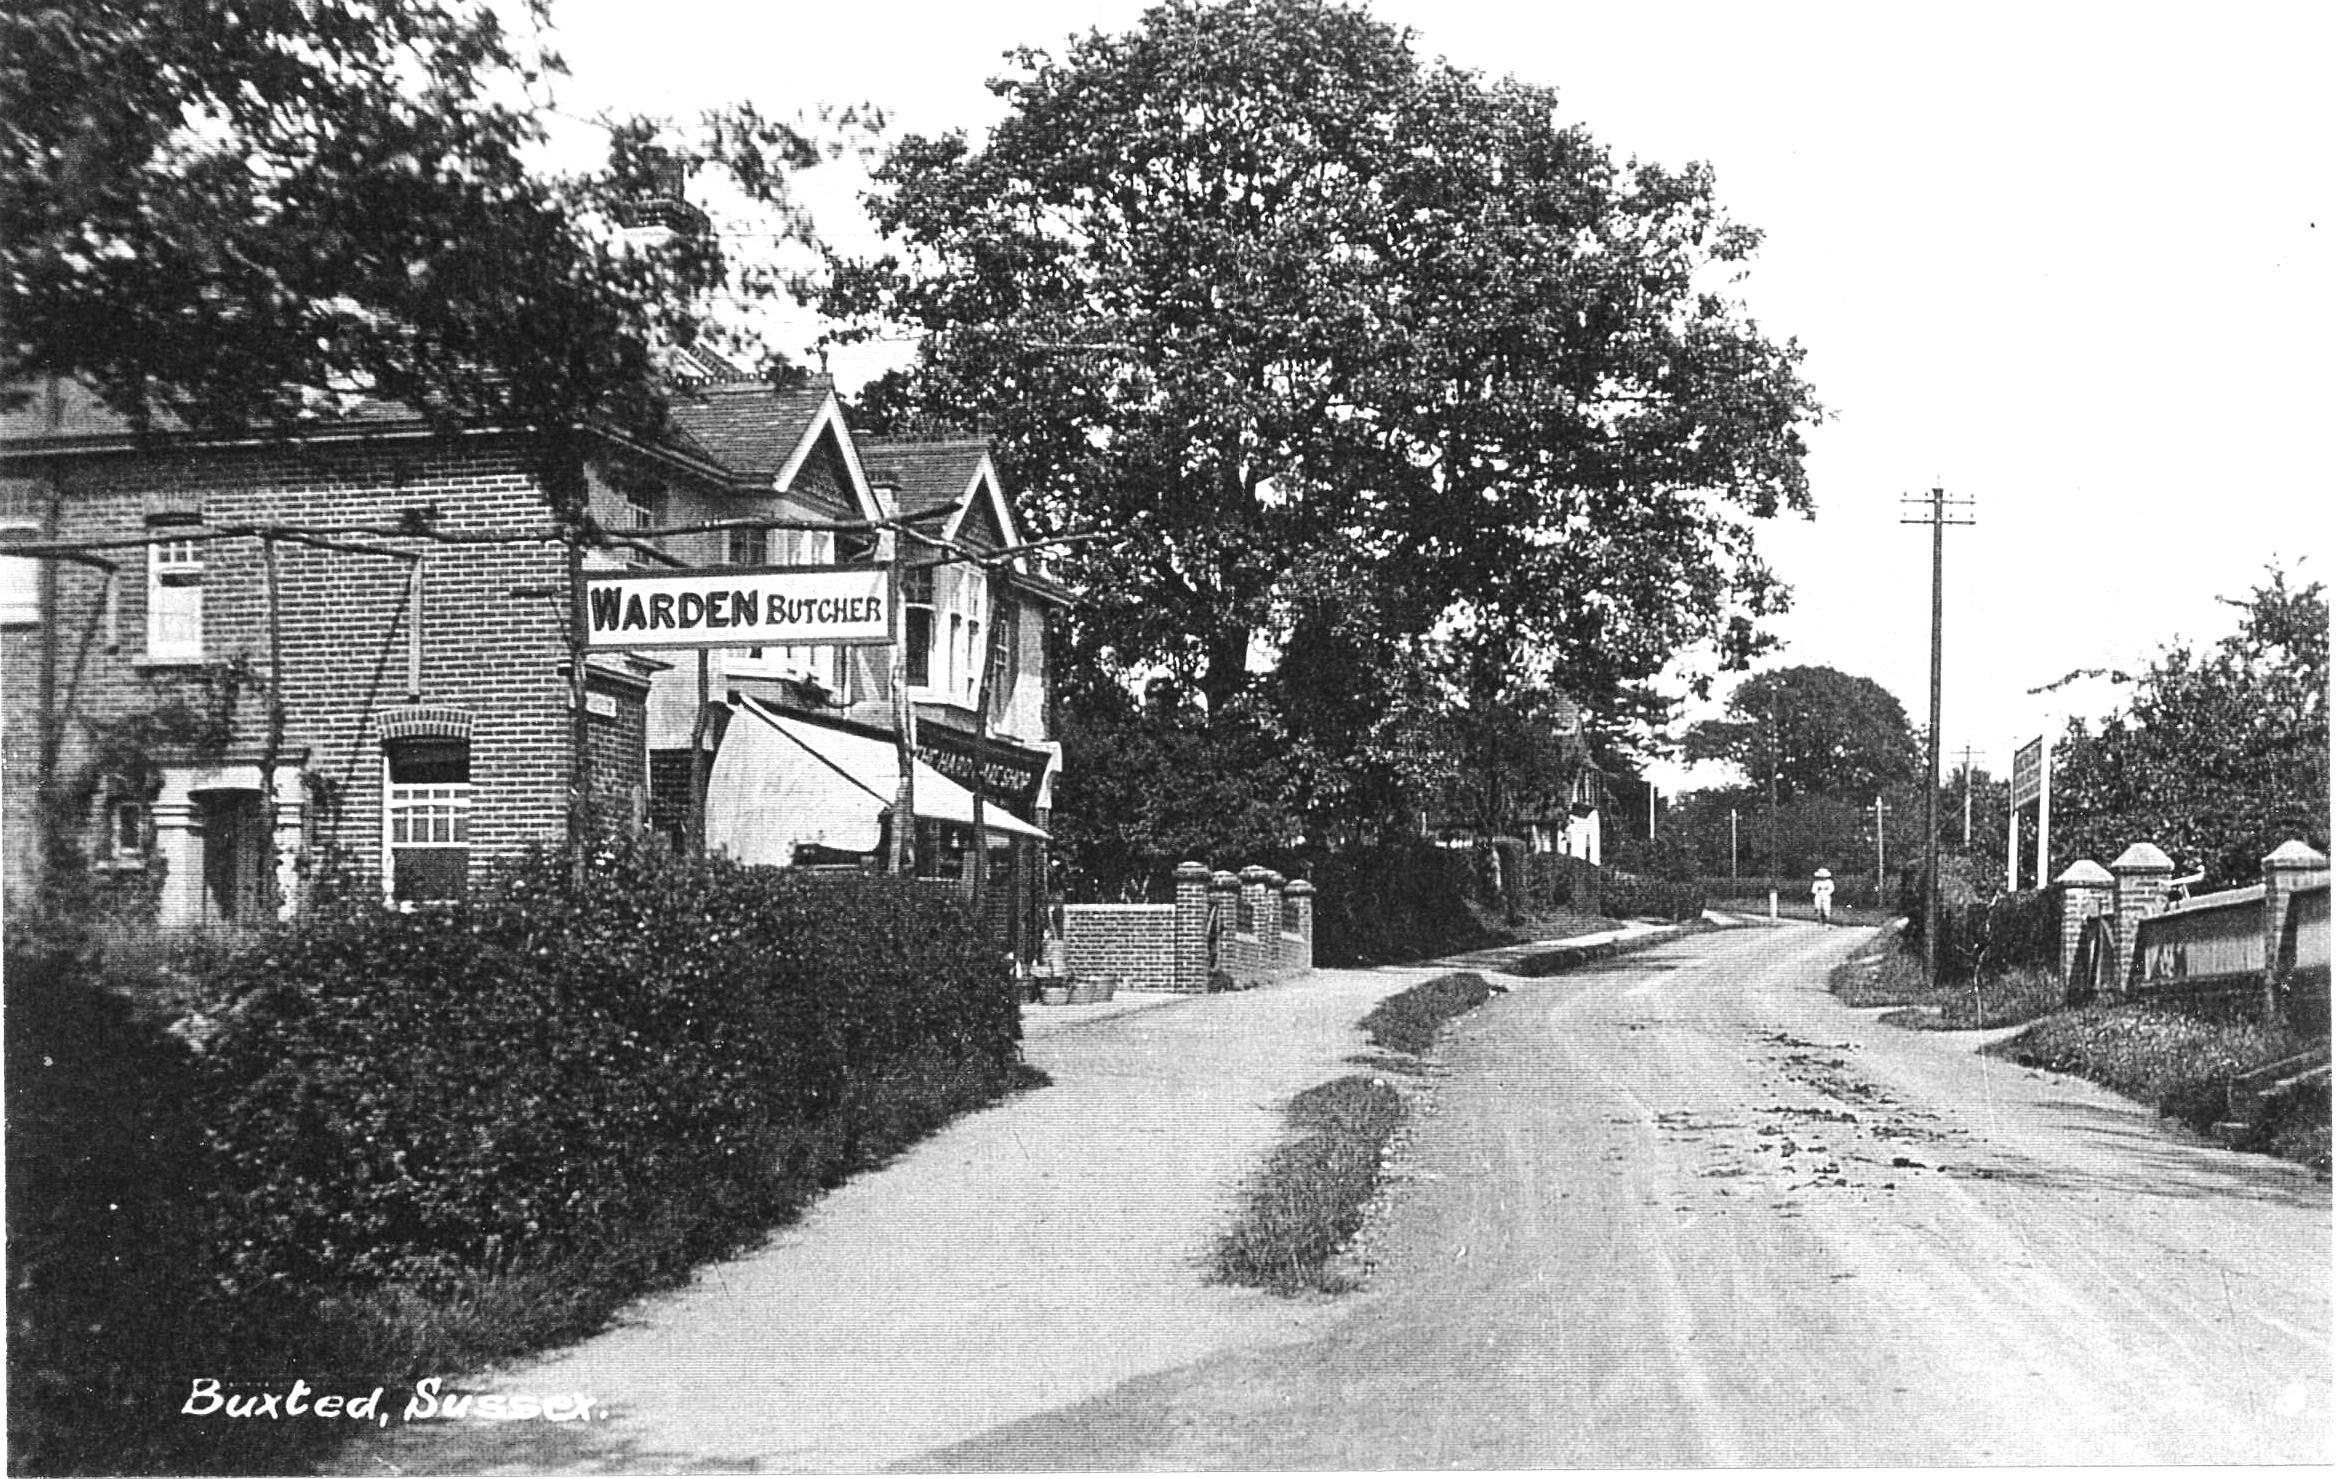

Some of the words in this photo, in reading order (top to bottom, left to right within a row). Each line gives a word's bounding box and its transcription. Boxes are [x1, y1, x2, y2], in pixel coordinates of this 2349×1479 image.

[590, 586, 759, 631] WARDEN
[765, 594, 881, 625] BUTCHER
[935, 751, 1004, 785] HARDARE
